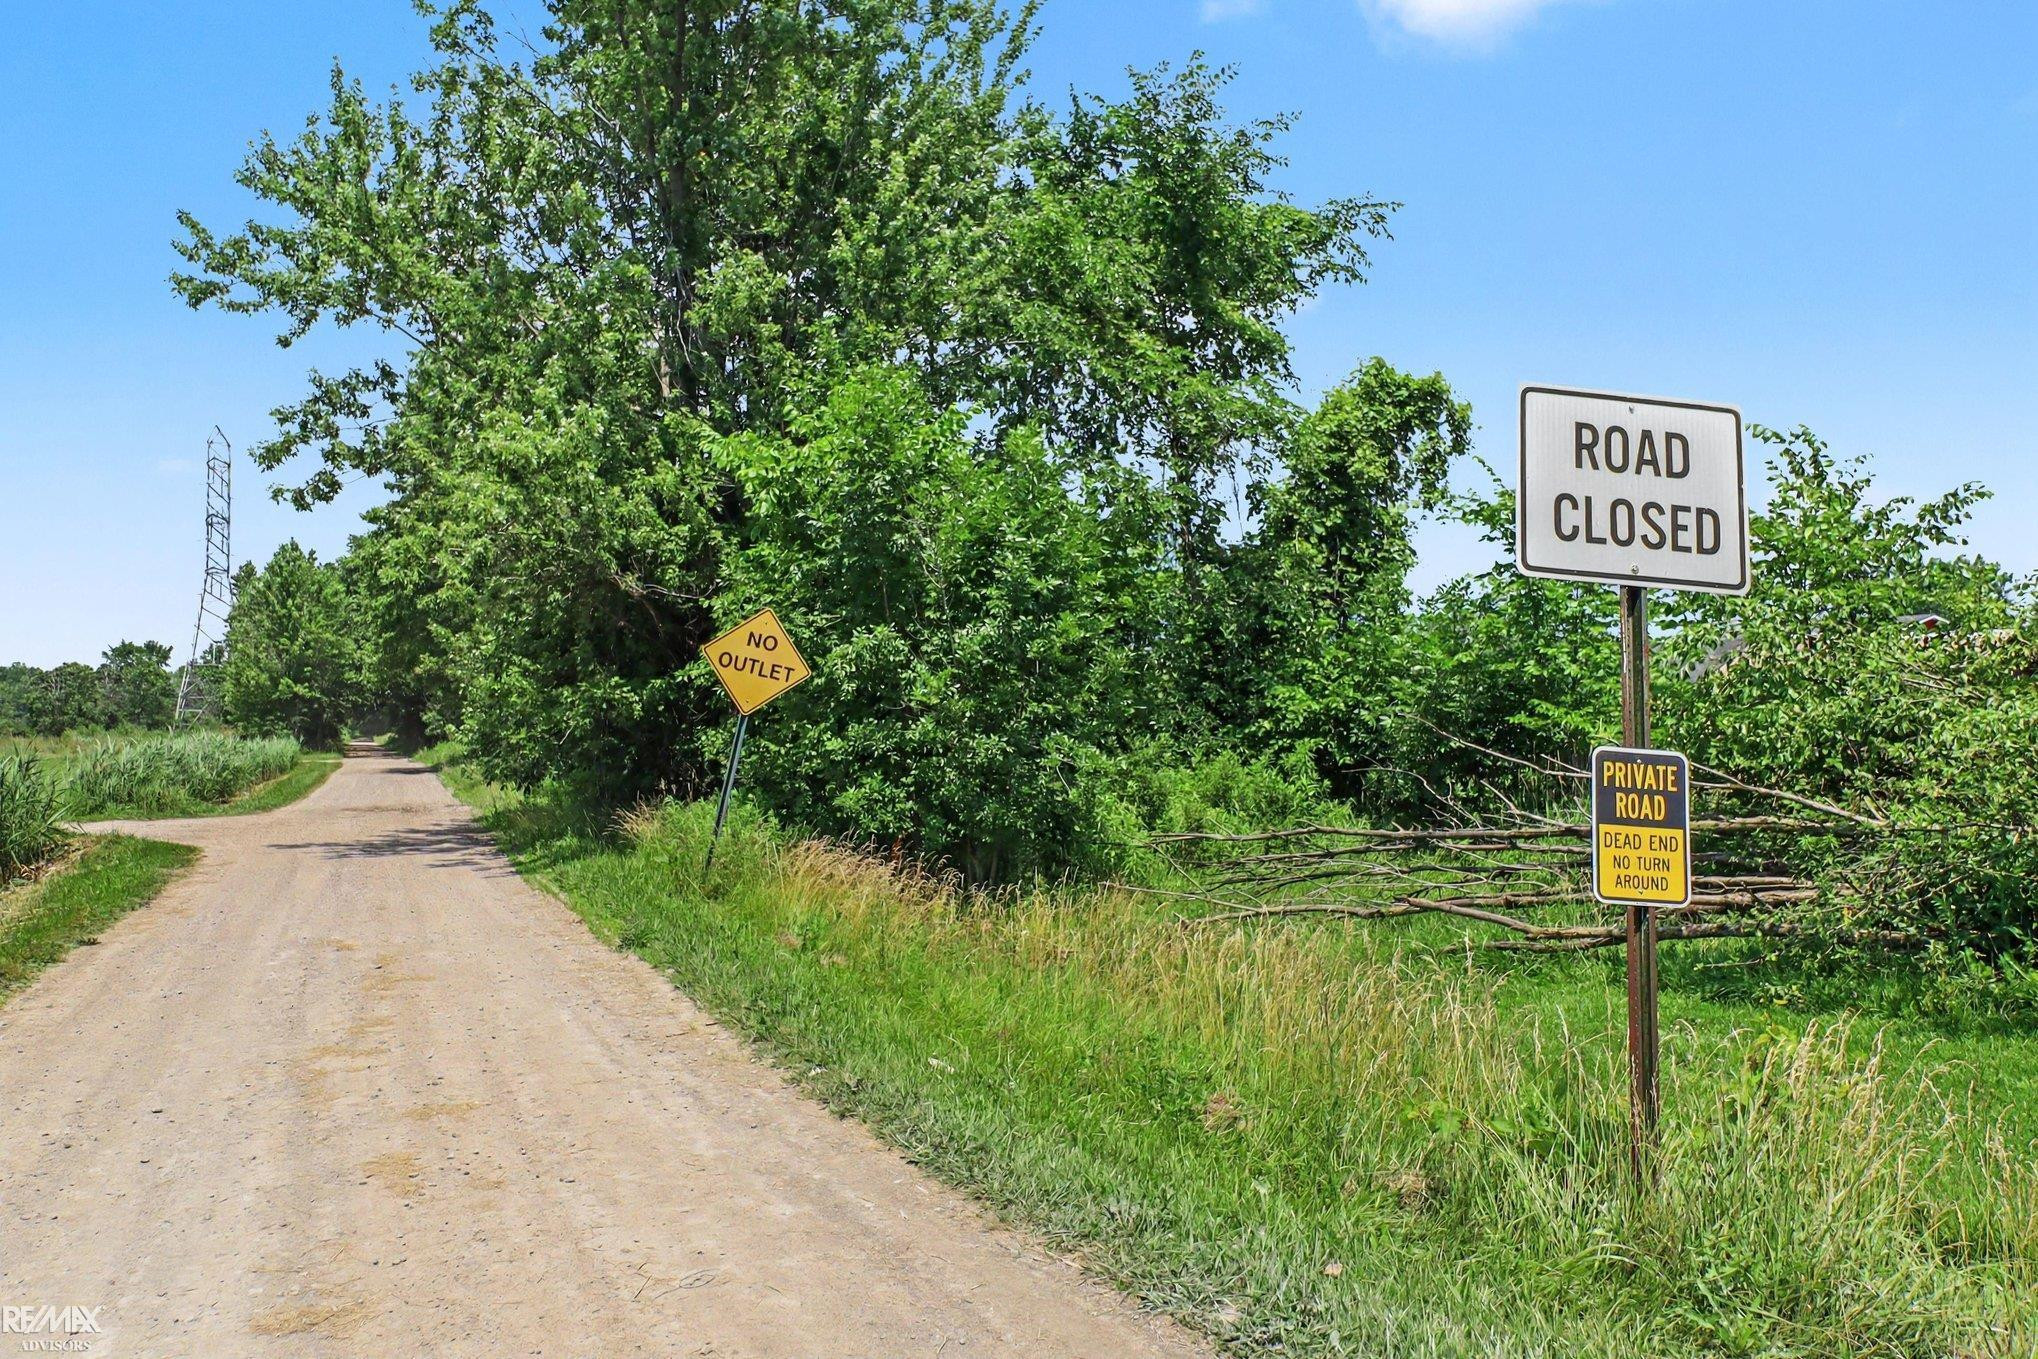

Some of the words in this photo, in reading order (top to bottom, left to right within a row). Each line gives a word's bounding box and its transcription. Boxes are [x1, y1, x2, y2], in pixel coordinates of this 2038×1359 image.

[1574, 421, 1690, 479] ROAD
[1553, 492, 1721, 555] CLOSED
[746, 631, 779, 652] NO
[718, 651, 795, 683] OUTLET
[1603, 760, 1678, 792] PRIVATE
[1615, 792, 1666, 821] ROAD
[1604, 831, 1642, 850] DEAD
[1650, 834, 1679, 853] END
[1613, 854, 1631, 870] NO
[1637, 856, 1670, 872] TURN
[1615, 874, 1669, 892] AROUND
